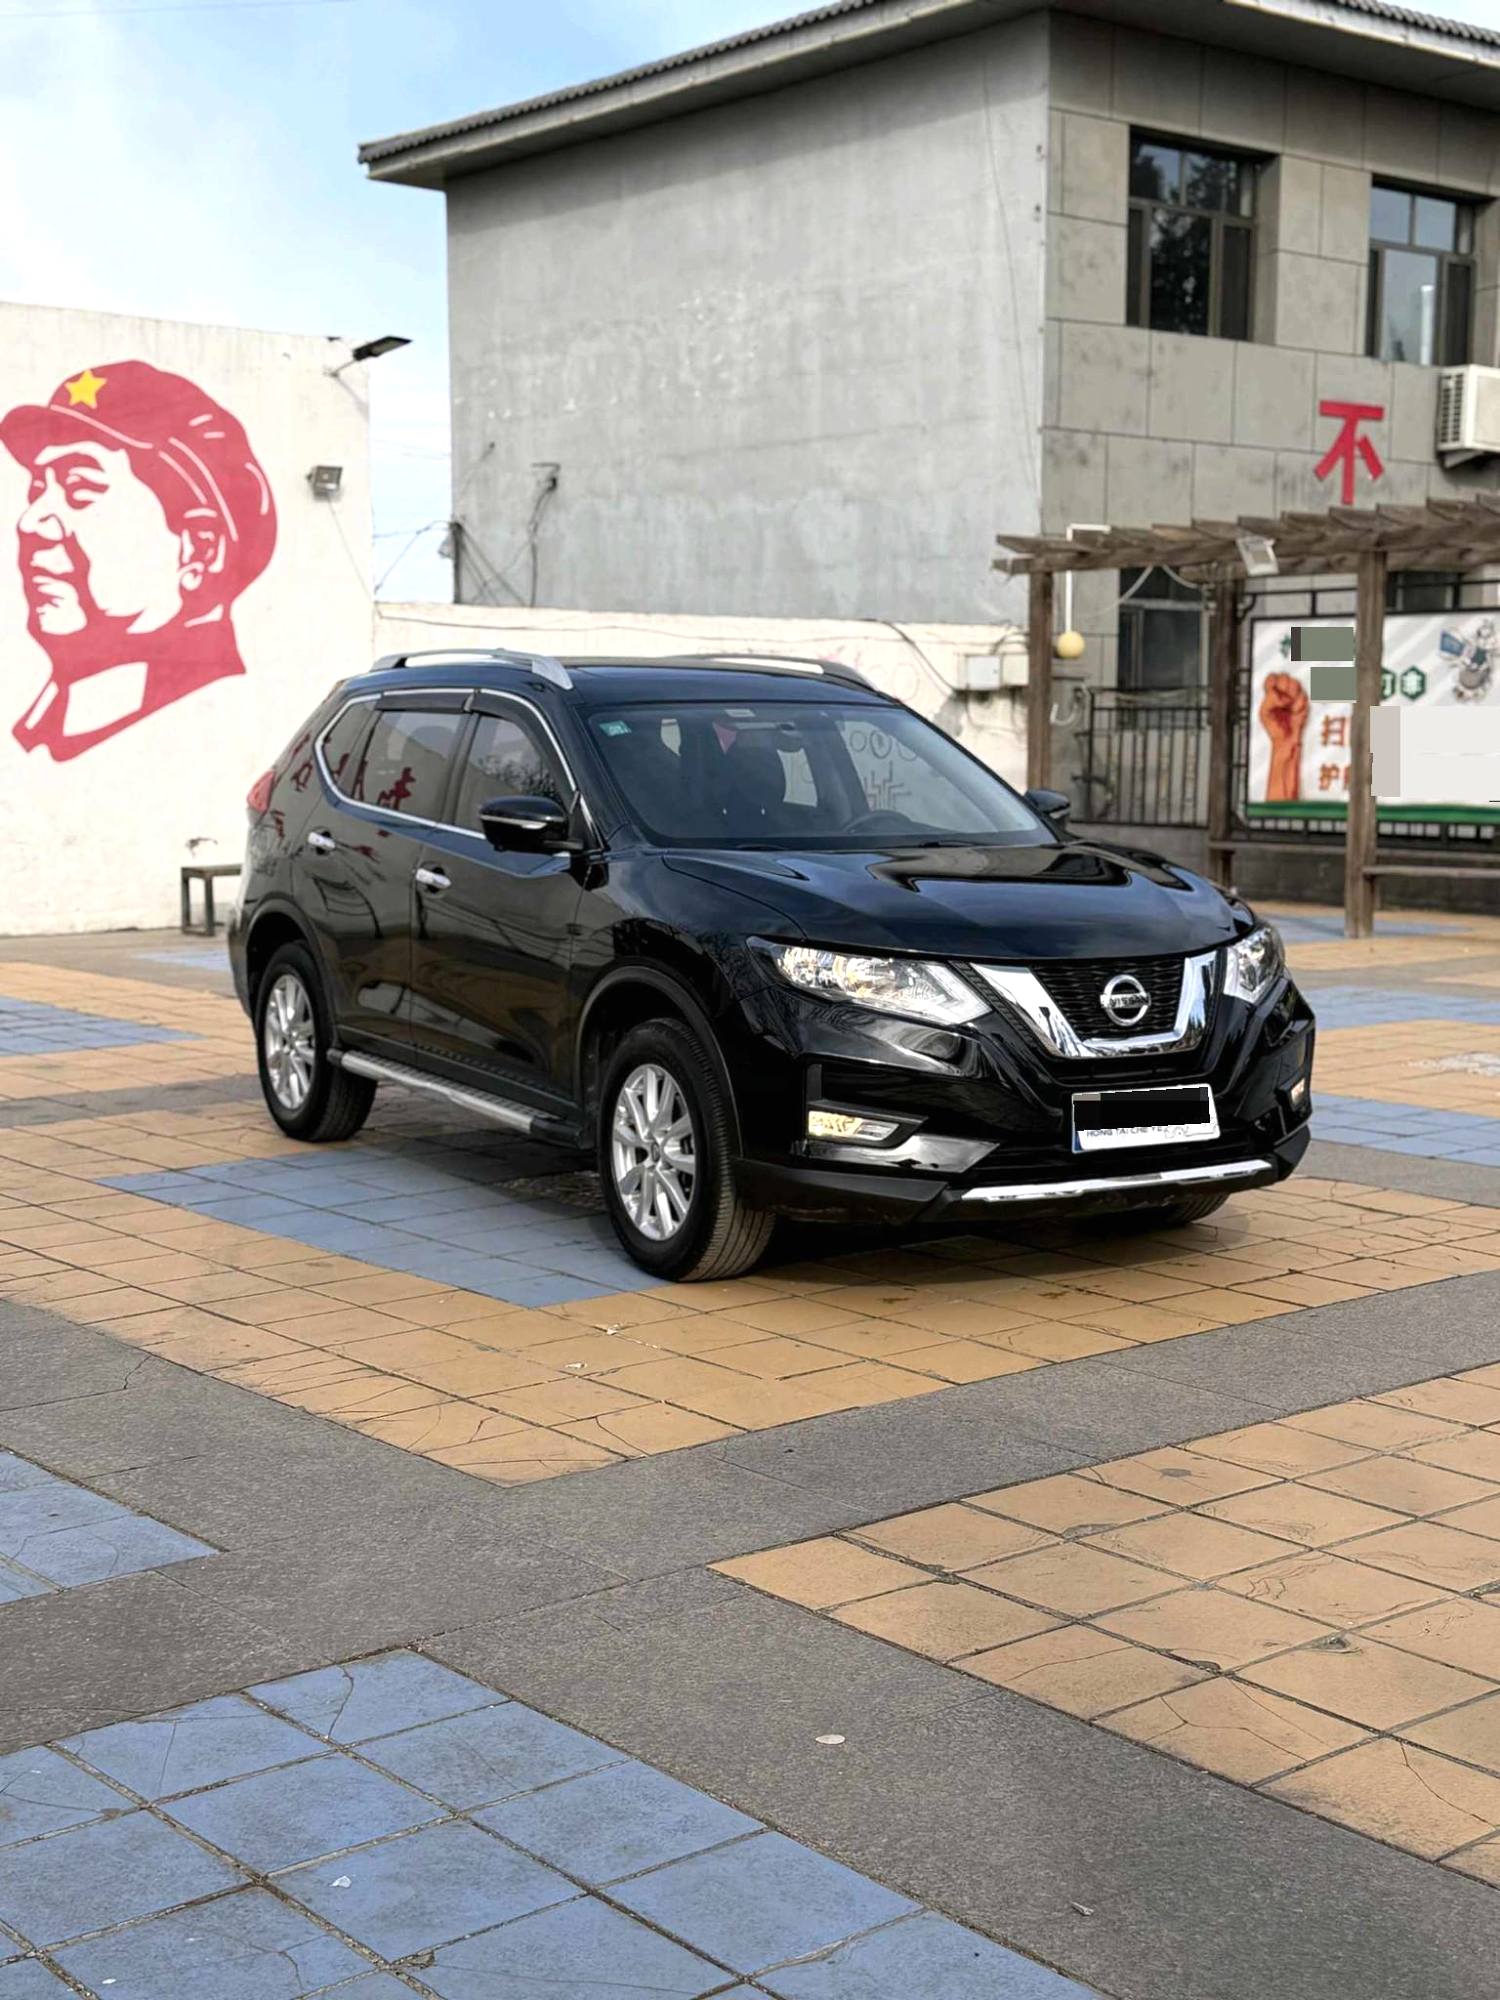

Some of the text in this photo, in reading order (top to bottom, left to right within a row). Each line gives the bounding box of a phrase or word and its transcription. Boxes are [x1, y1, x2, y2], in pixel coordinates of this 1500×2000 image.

[1314, 400, 1384, 505] 不
[1318, 763, 1350, 792] 护
[1108, 993, 1149, 1008] NISSAN
